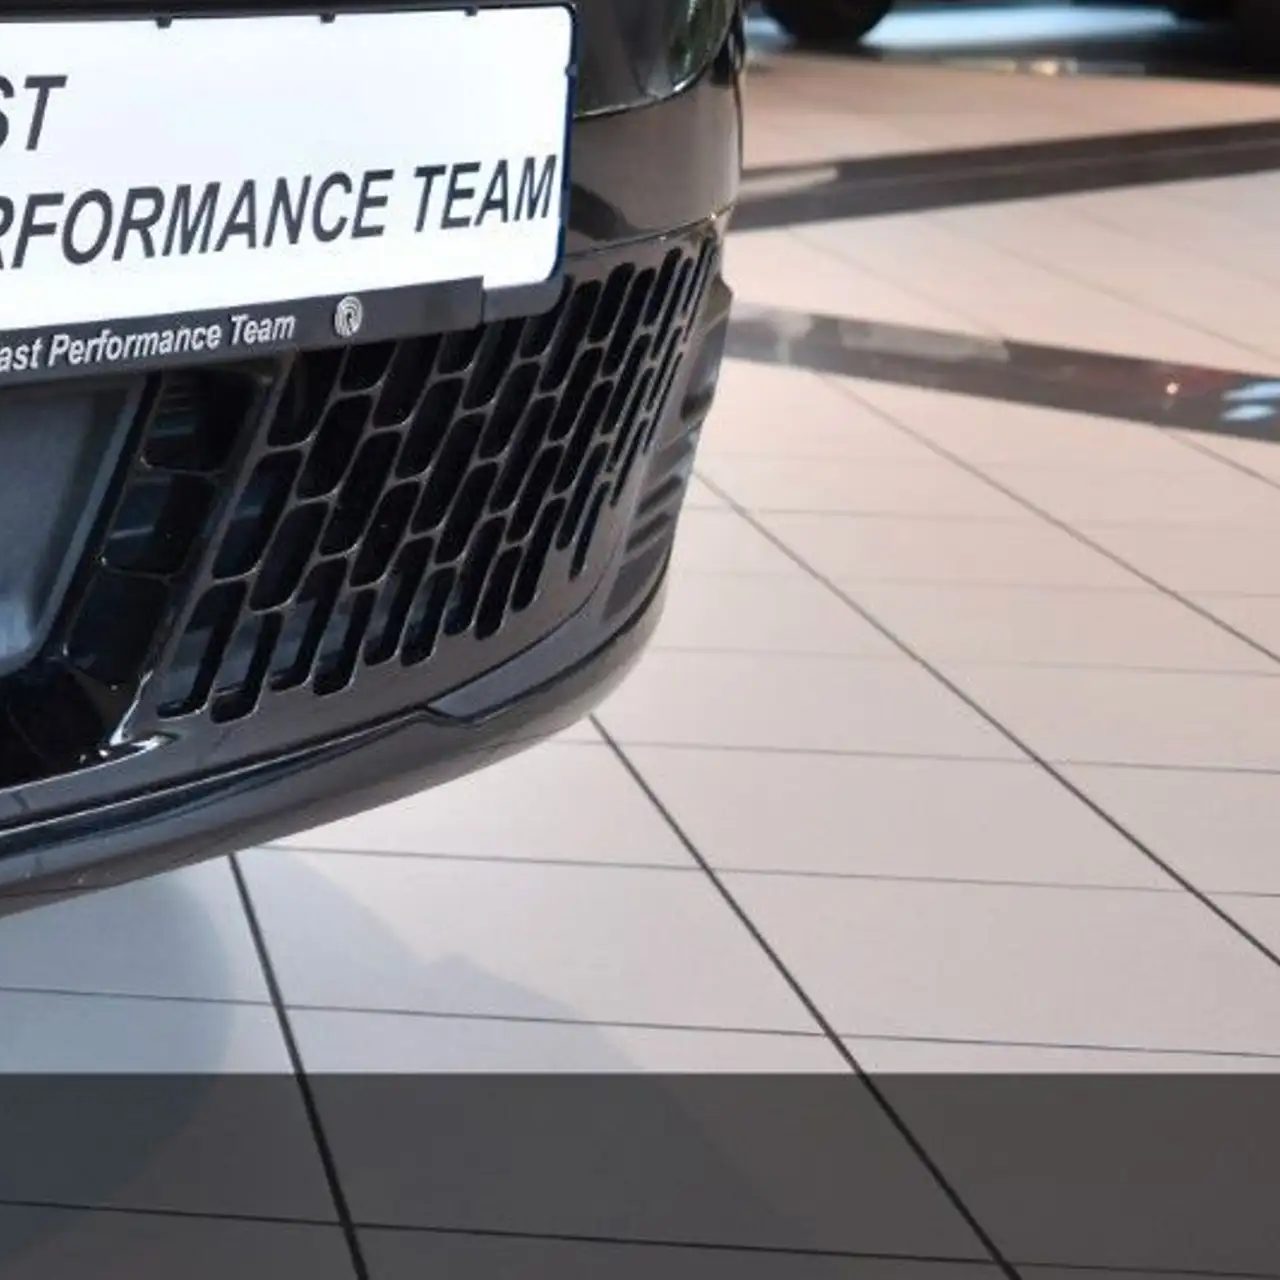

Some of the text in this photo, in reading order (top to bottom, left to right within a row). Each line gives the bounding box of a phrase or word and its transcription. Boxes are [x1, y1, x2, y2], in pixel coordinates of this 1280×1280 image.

[413, 153, 558, 234] TEAM
[47, 322, 222, 368] Performance
[229, 313, 297, 346] Team
